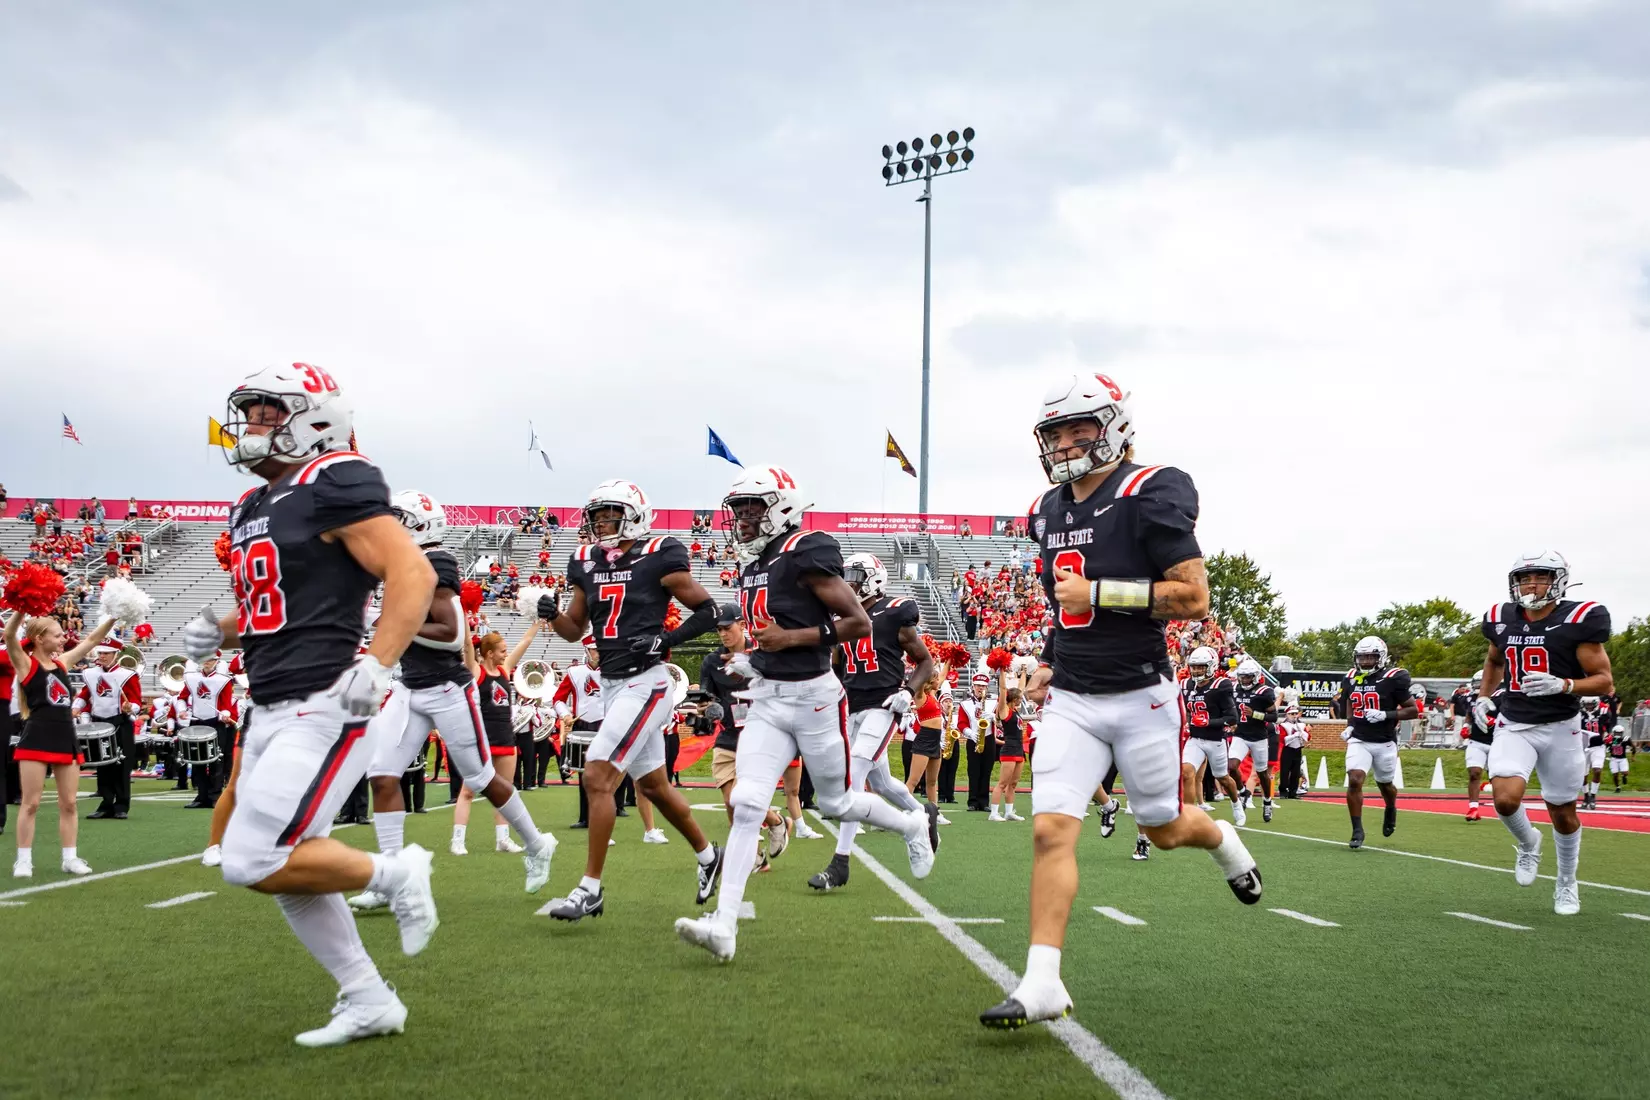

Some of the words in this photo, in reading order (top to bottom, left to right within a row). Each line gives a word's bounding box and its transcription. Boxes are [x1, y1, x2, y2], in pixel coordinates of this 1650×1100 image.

[768, 468, 796, 490] 14
[246, 516, 270, 538] STATE
[1046, 533, 1066, 549] BALL
[1068, 528, 1094, 546] STATE
[593, 572, 611, 583] BALL
[612, 570, 632, 581] STATE
[754, 572, 769, 587] STATE
[599, 583, 626, 639] 7
[1507, 635, 1522, 645] BALL
[1523, 635, 1545, 645] STATE
[840, 636, 880, 674] 14
[1350, 692, 1380, 718] 20
